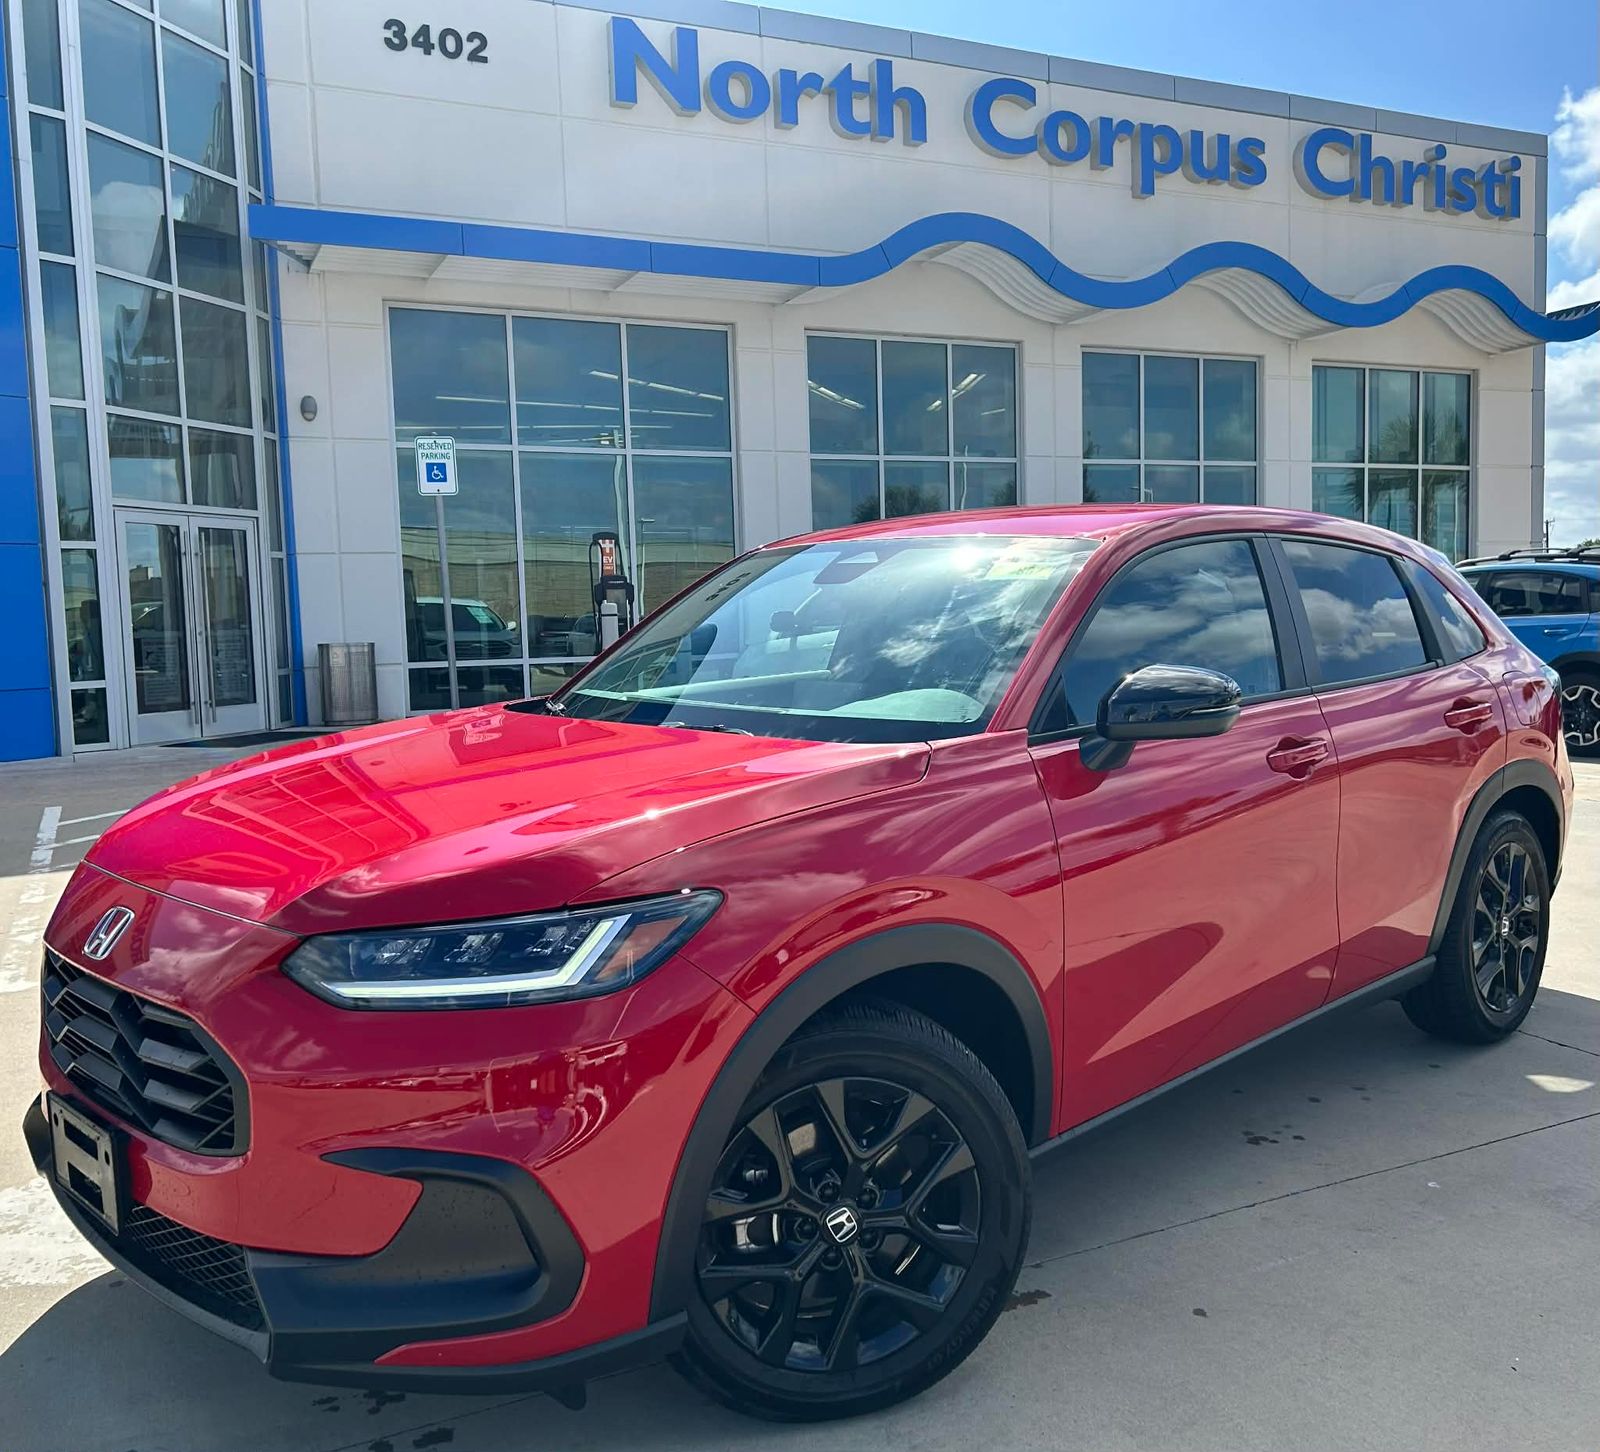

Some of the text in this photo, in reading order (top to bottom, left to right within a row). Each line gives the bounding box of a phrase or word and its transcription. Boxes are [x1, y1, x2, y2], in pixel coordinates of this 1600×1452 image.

[383, 18, 489, 64] 3402
[608, 16, 1521, 220] North Corpus Christi
[418, 442, 452, 450] RESERVED
[421, 452, 450, 460] PARKING
[603, 556, 613, 564] EV
